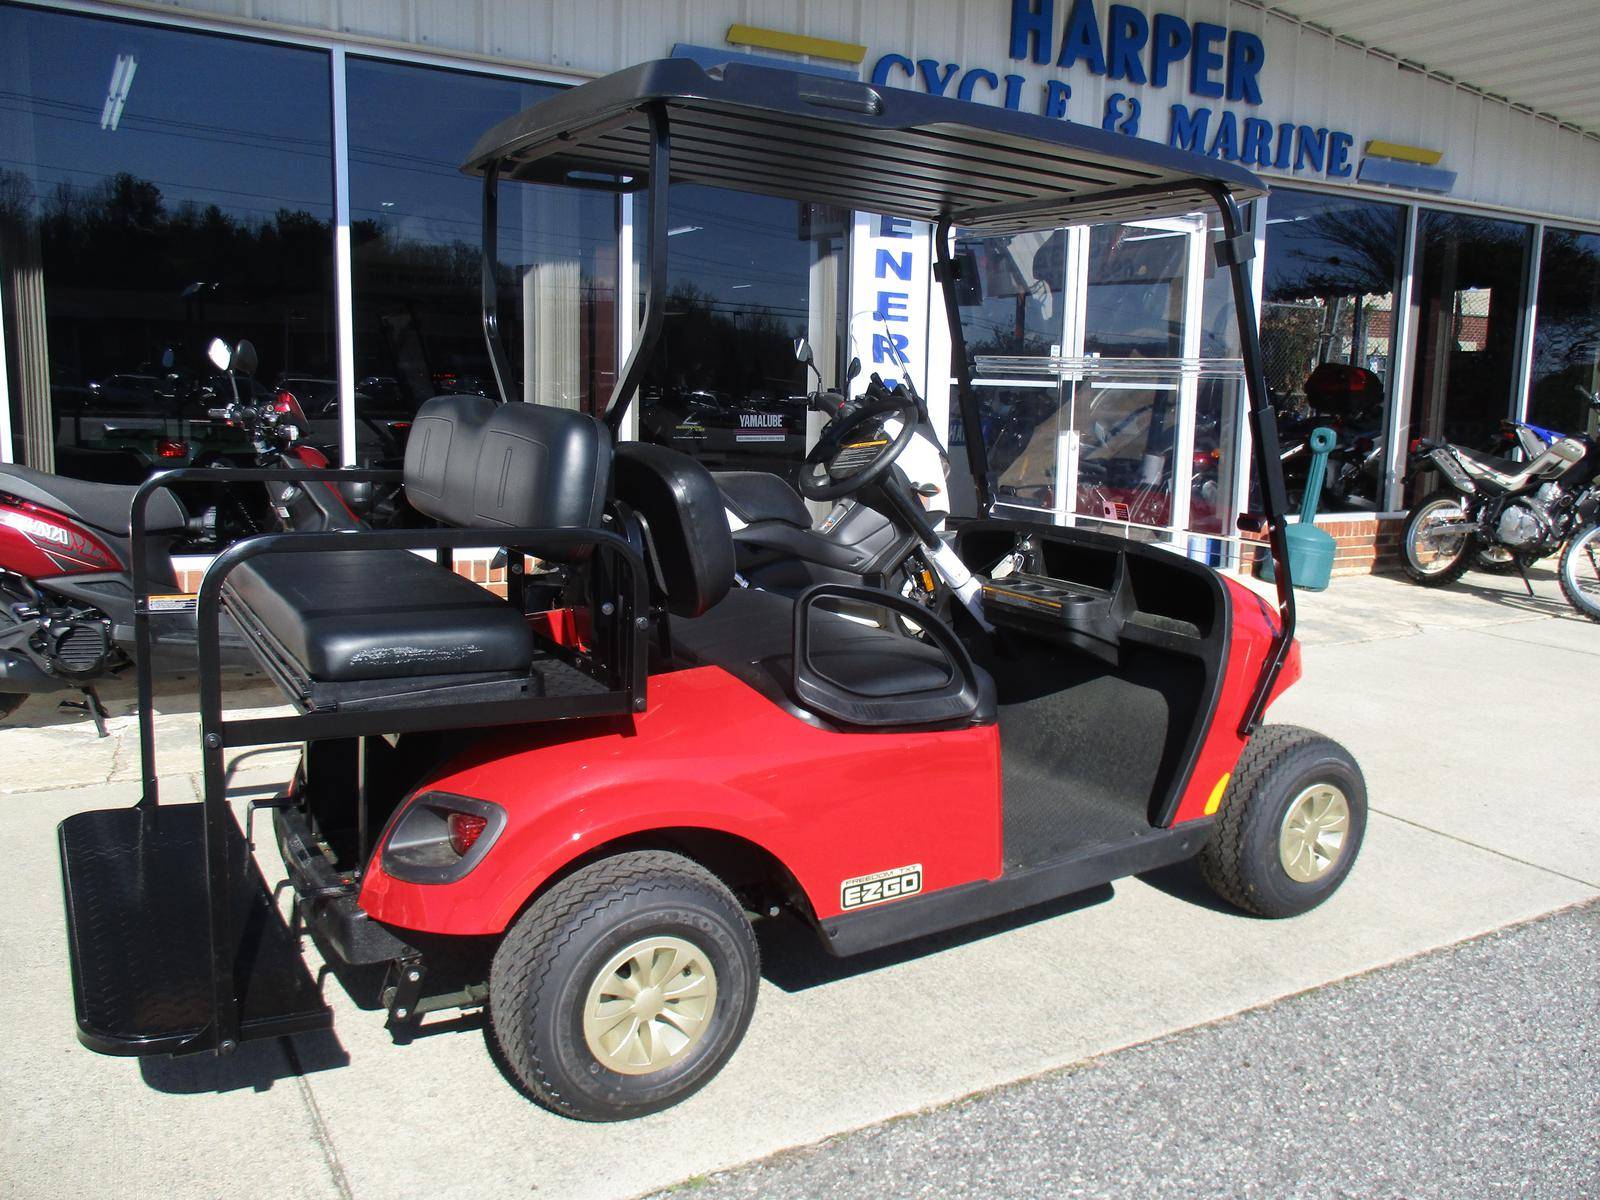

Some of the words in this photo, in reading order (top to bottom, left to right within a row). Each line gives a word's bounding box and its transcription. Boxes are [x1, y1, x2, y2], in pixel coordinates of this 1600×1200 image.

[1010, 0, 1264, 105] HARPER
[1102, 92, 1142, 137] &
[1170, 104, 1354, 177] MARINE
[872, 215, 913, 392] ENER
[739, 414, 783, 428] YAMALUBE
[845, 870, 894, 886] FREEDOM
[899, 865, 917, 874] TXT
